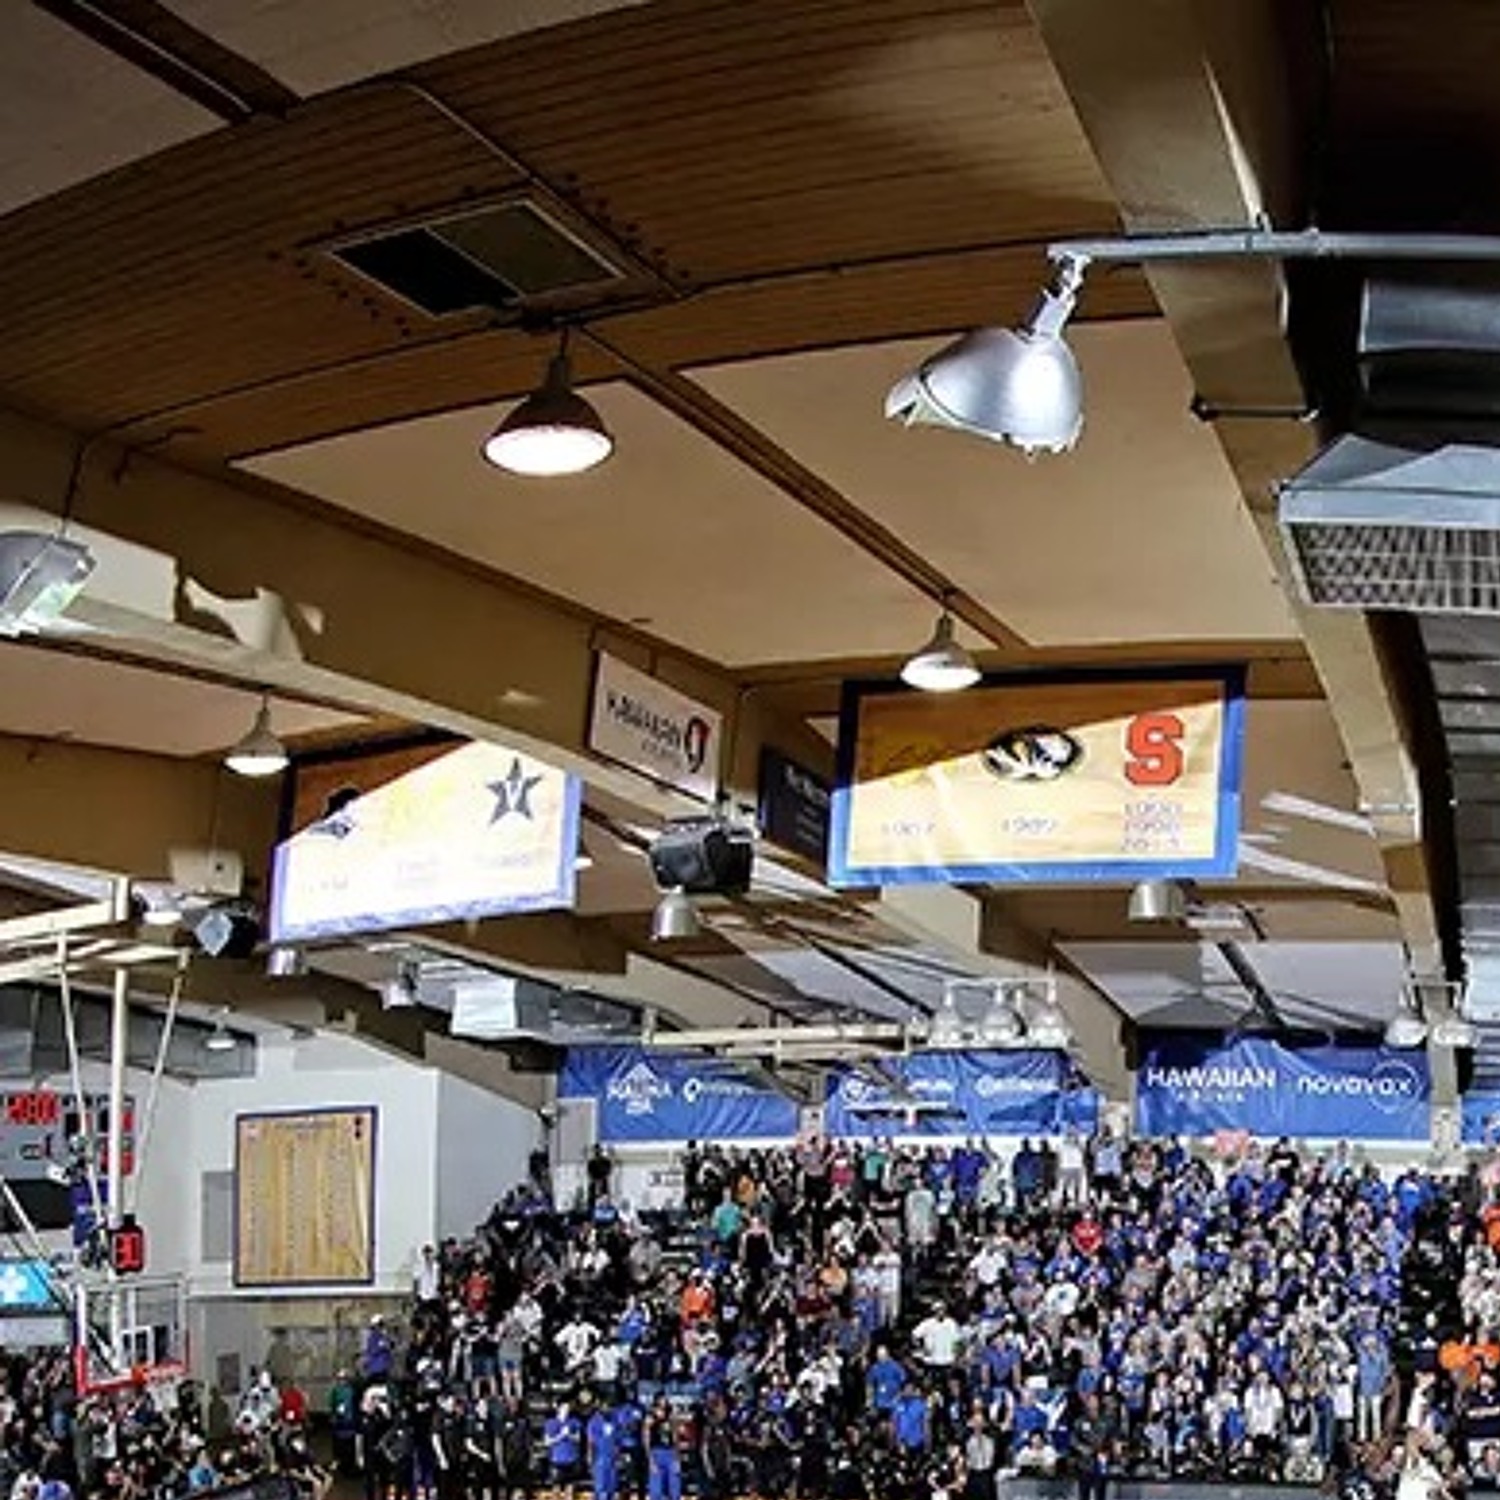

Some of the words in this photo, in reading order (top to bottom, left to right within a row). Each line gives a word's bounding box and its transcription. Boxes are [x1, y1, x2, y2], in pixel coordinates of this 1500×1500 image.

[1124, 713, 1185, 786] S
[1148, 1066, 1276, 1088] HAWAIIAN
[1298, 1076, 1412, 1096] novavax
